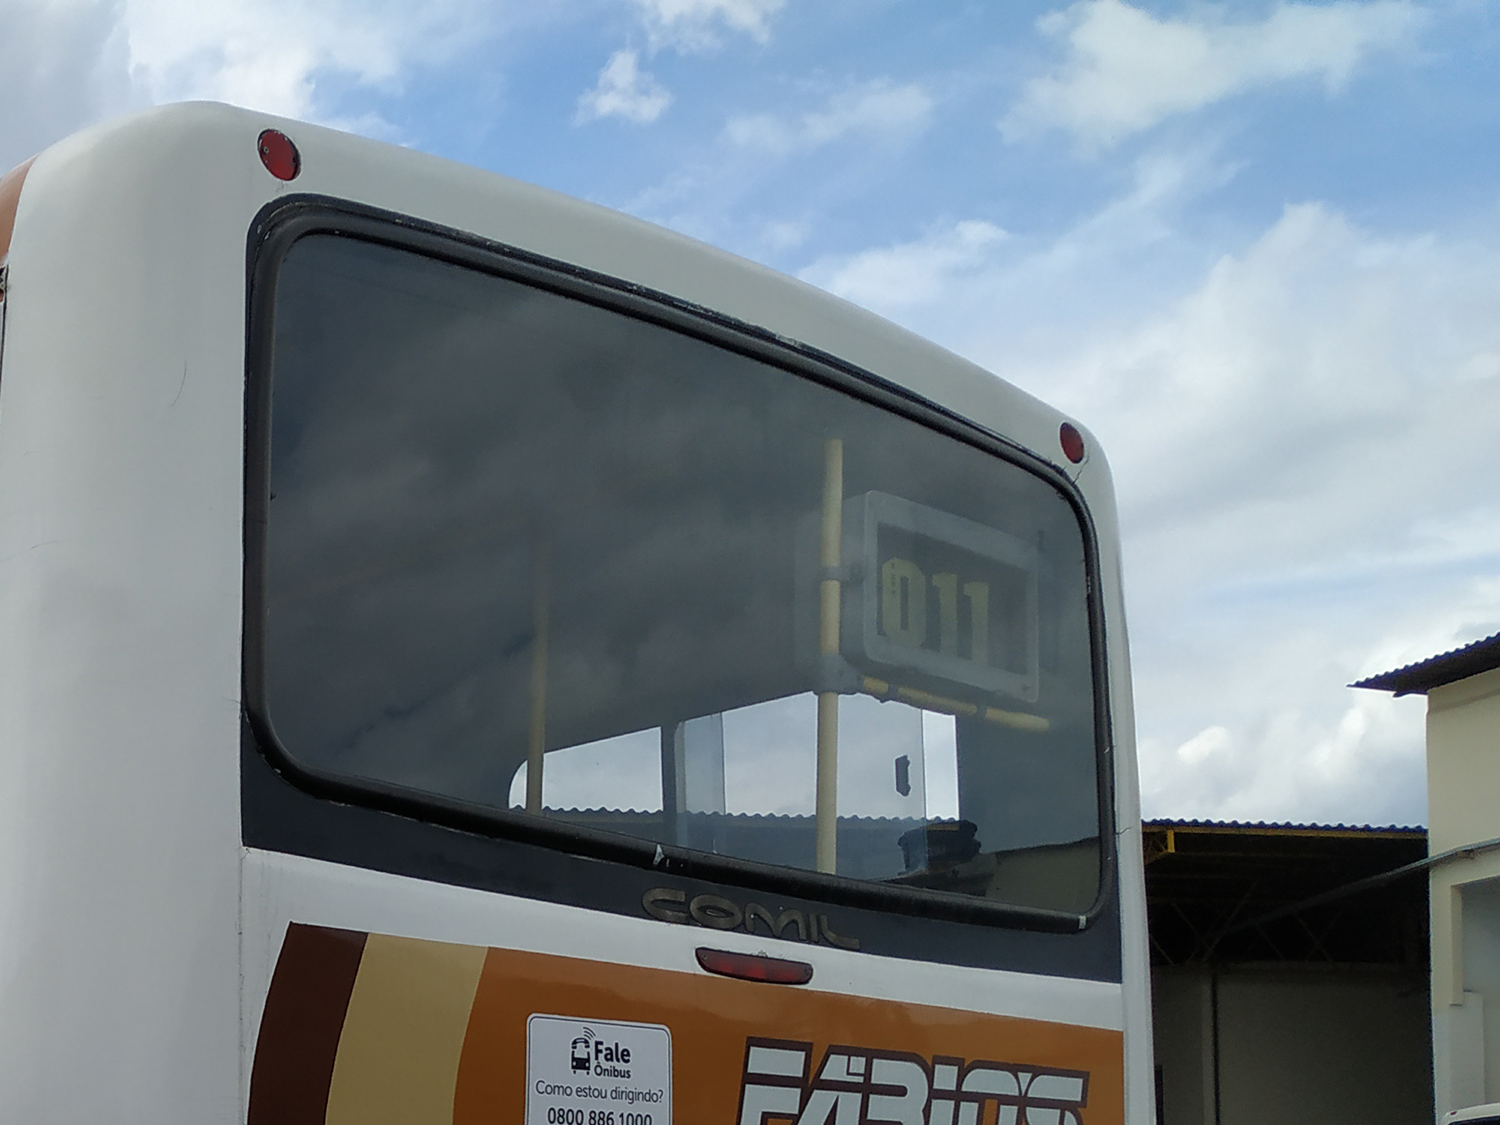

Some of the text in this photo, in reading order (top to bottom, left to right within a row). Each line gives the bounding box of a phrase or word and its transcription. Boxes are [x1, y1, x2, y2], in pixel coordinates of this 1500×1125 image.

[882, 556, 989, 666] 011
[642, 888, 860, 950] COMIL
[594, 1040, 631, 1063] Fale
[594, 1061, 631, 1079] Ônibus
[535, 1080, 664, 1105] Como estou dirigindo?
[547, 1107, 584, 1125] 0800
